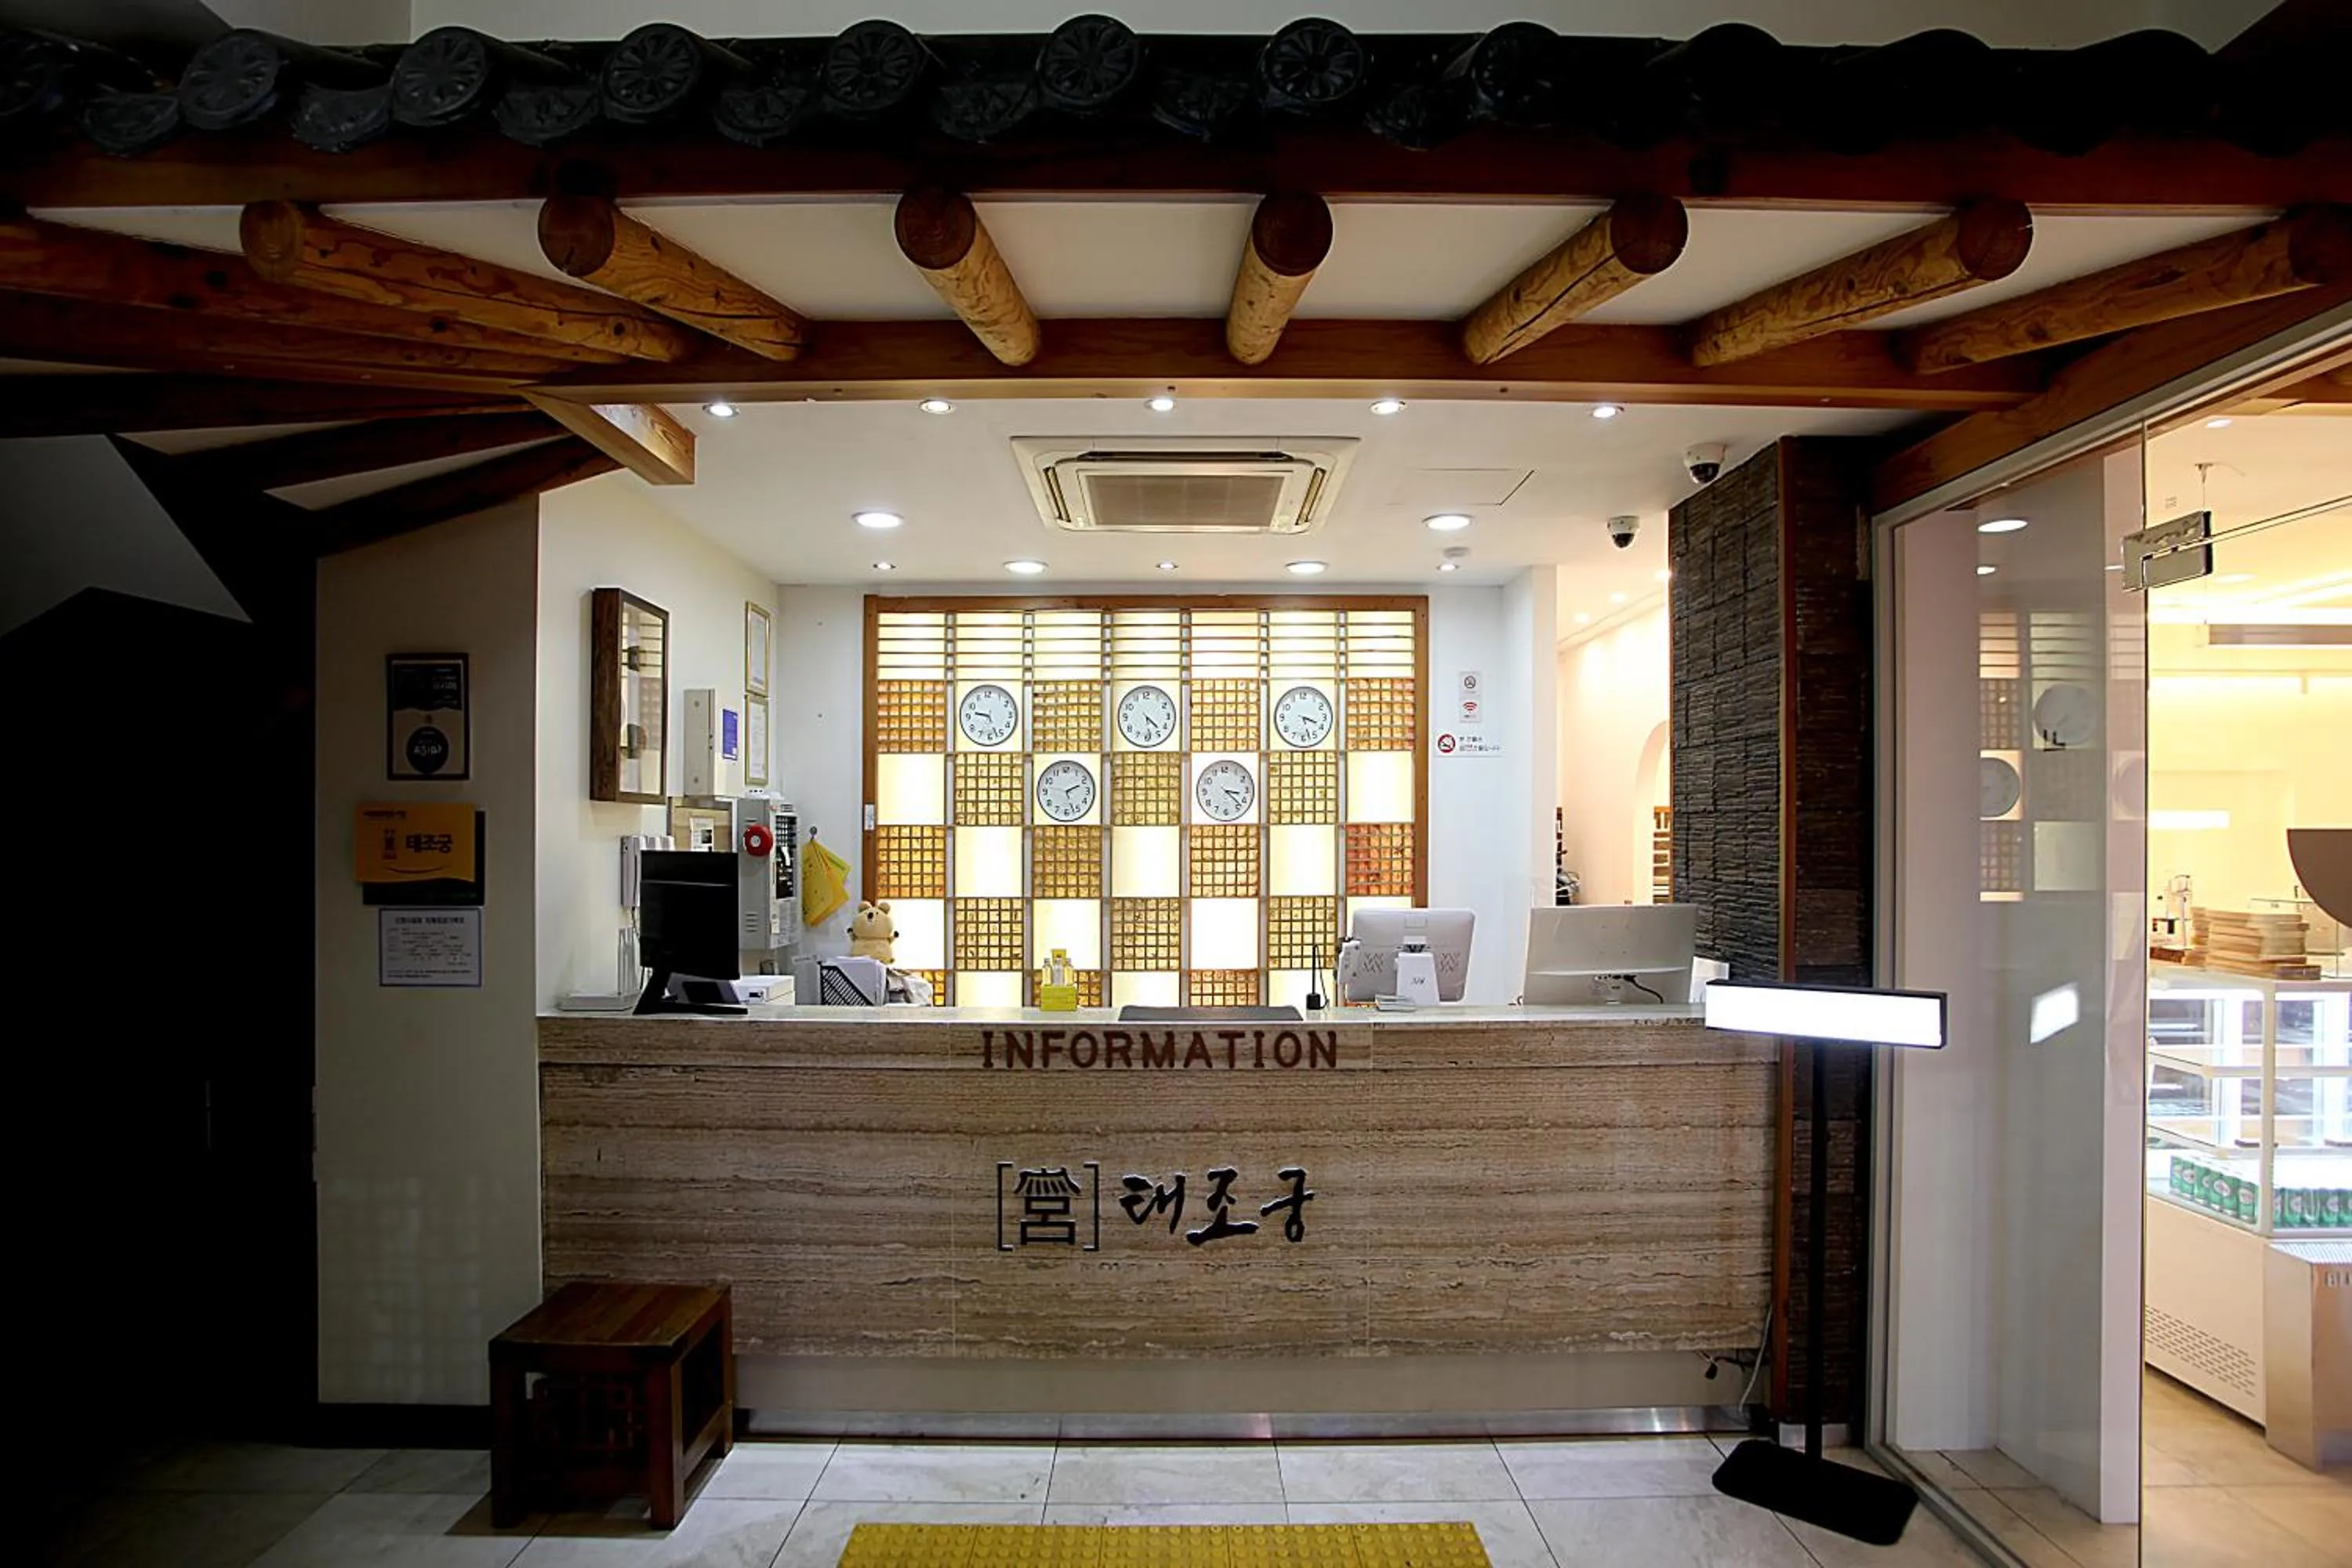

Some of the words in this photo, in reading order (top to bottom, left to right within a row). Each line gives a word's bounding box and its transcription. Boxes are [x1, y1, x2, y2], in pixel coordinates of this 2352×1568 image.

[406, 833, 452, 853] 태조궁
[982, 1030, 1338, 1069] INFORMATION
[1118, 1166, 1316, 1247] 태조궁
